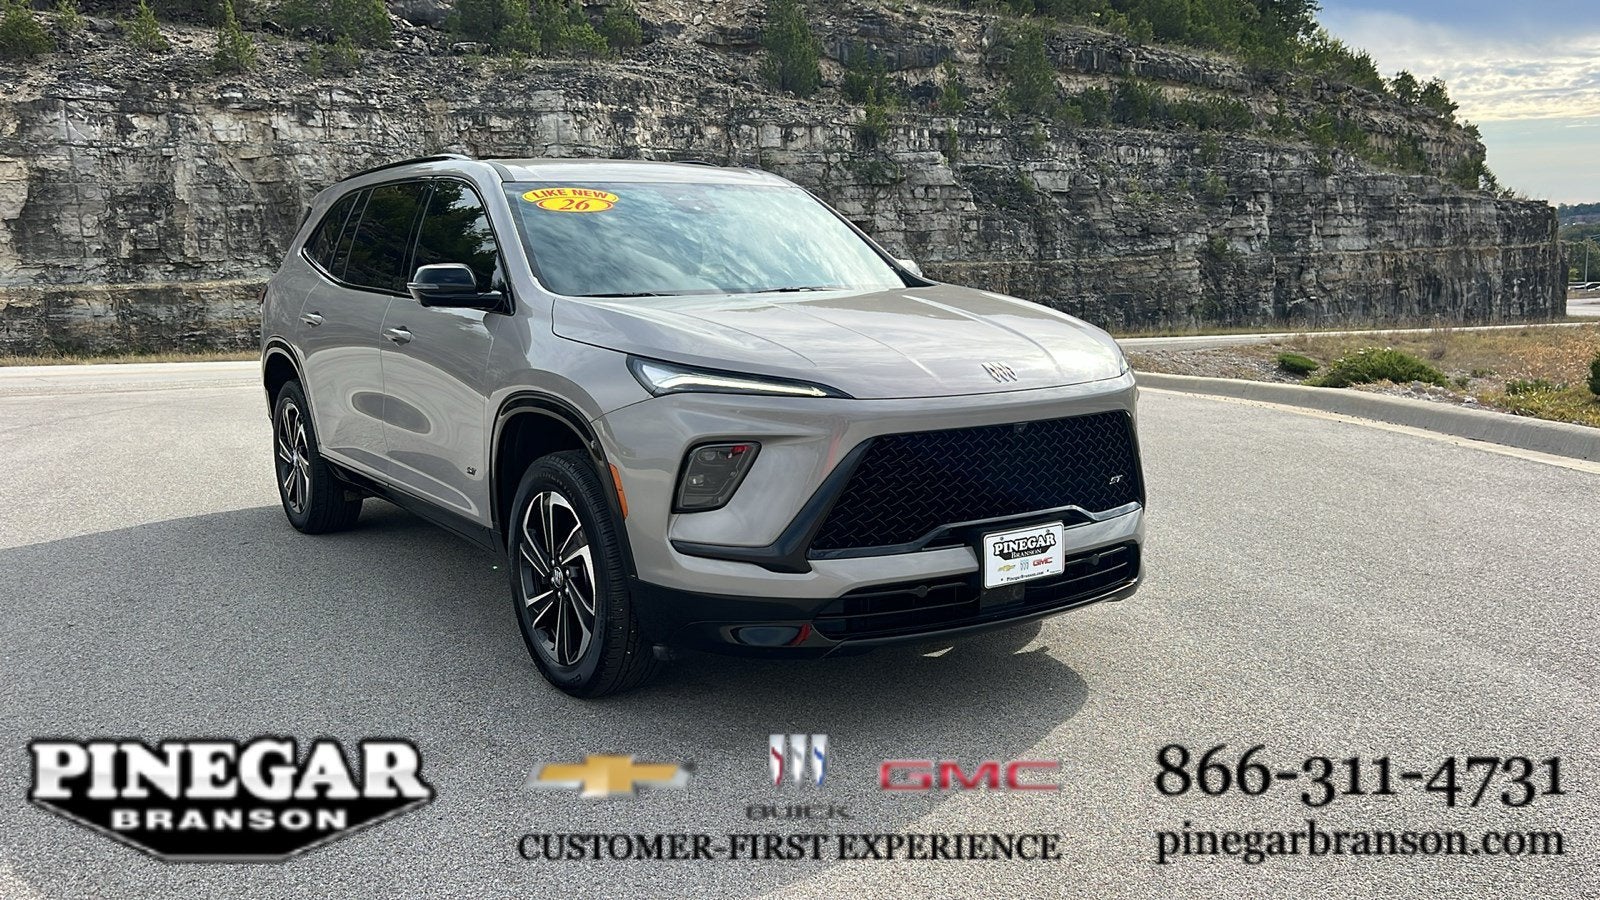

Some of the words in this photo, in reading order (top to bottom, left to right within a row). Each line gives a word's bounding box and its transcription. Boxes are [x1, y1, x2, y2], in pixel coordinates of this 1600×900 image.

[532, 188, 566, 199] LIKE
[571, 189, 608, 199] NEW
[559, 198, 590, 211] 26
[993, 533, 1056, 555] PINEGAR
[1032, 557, 1053, 567] GMC
